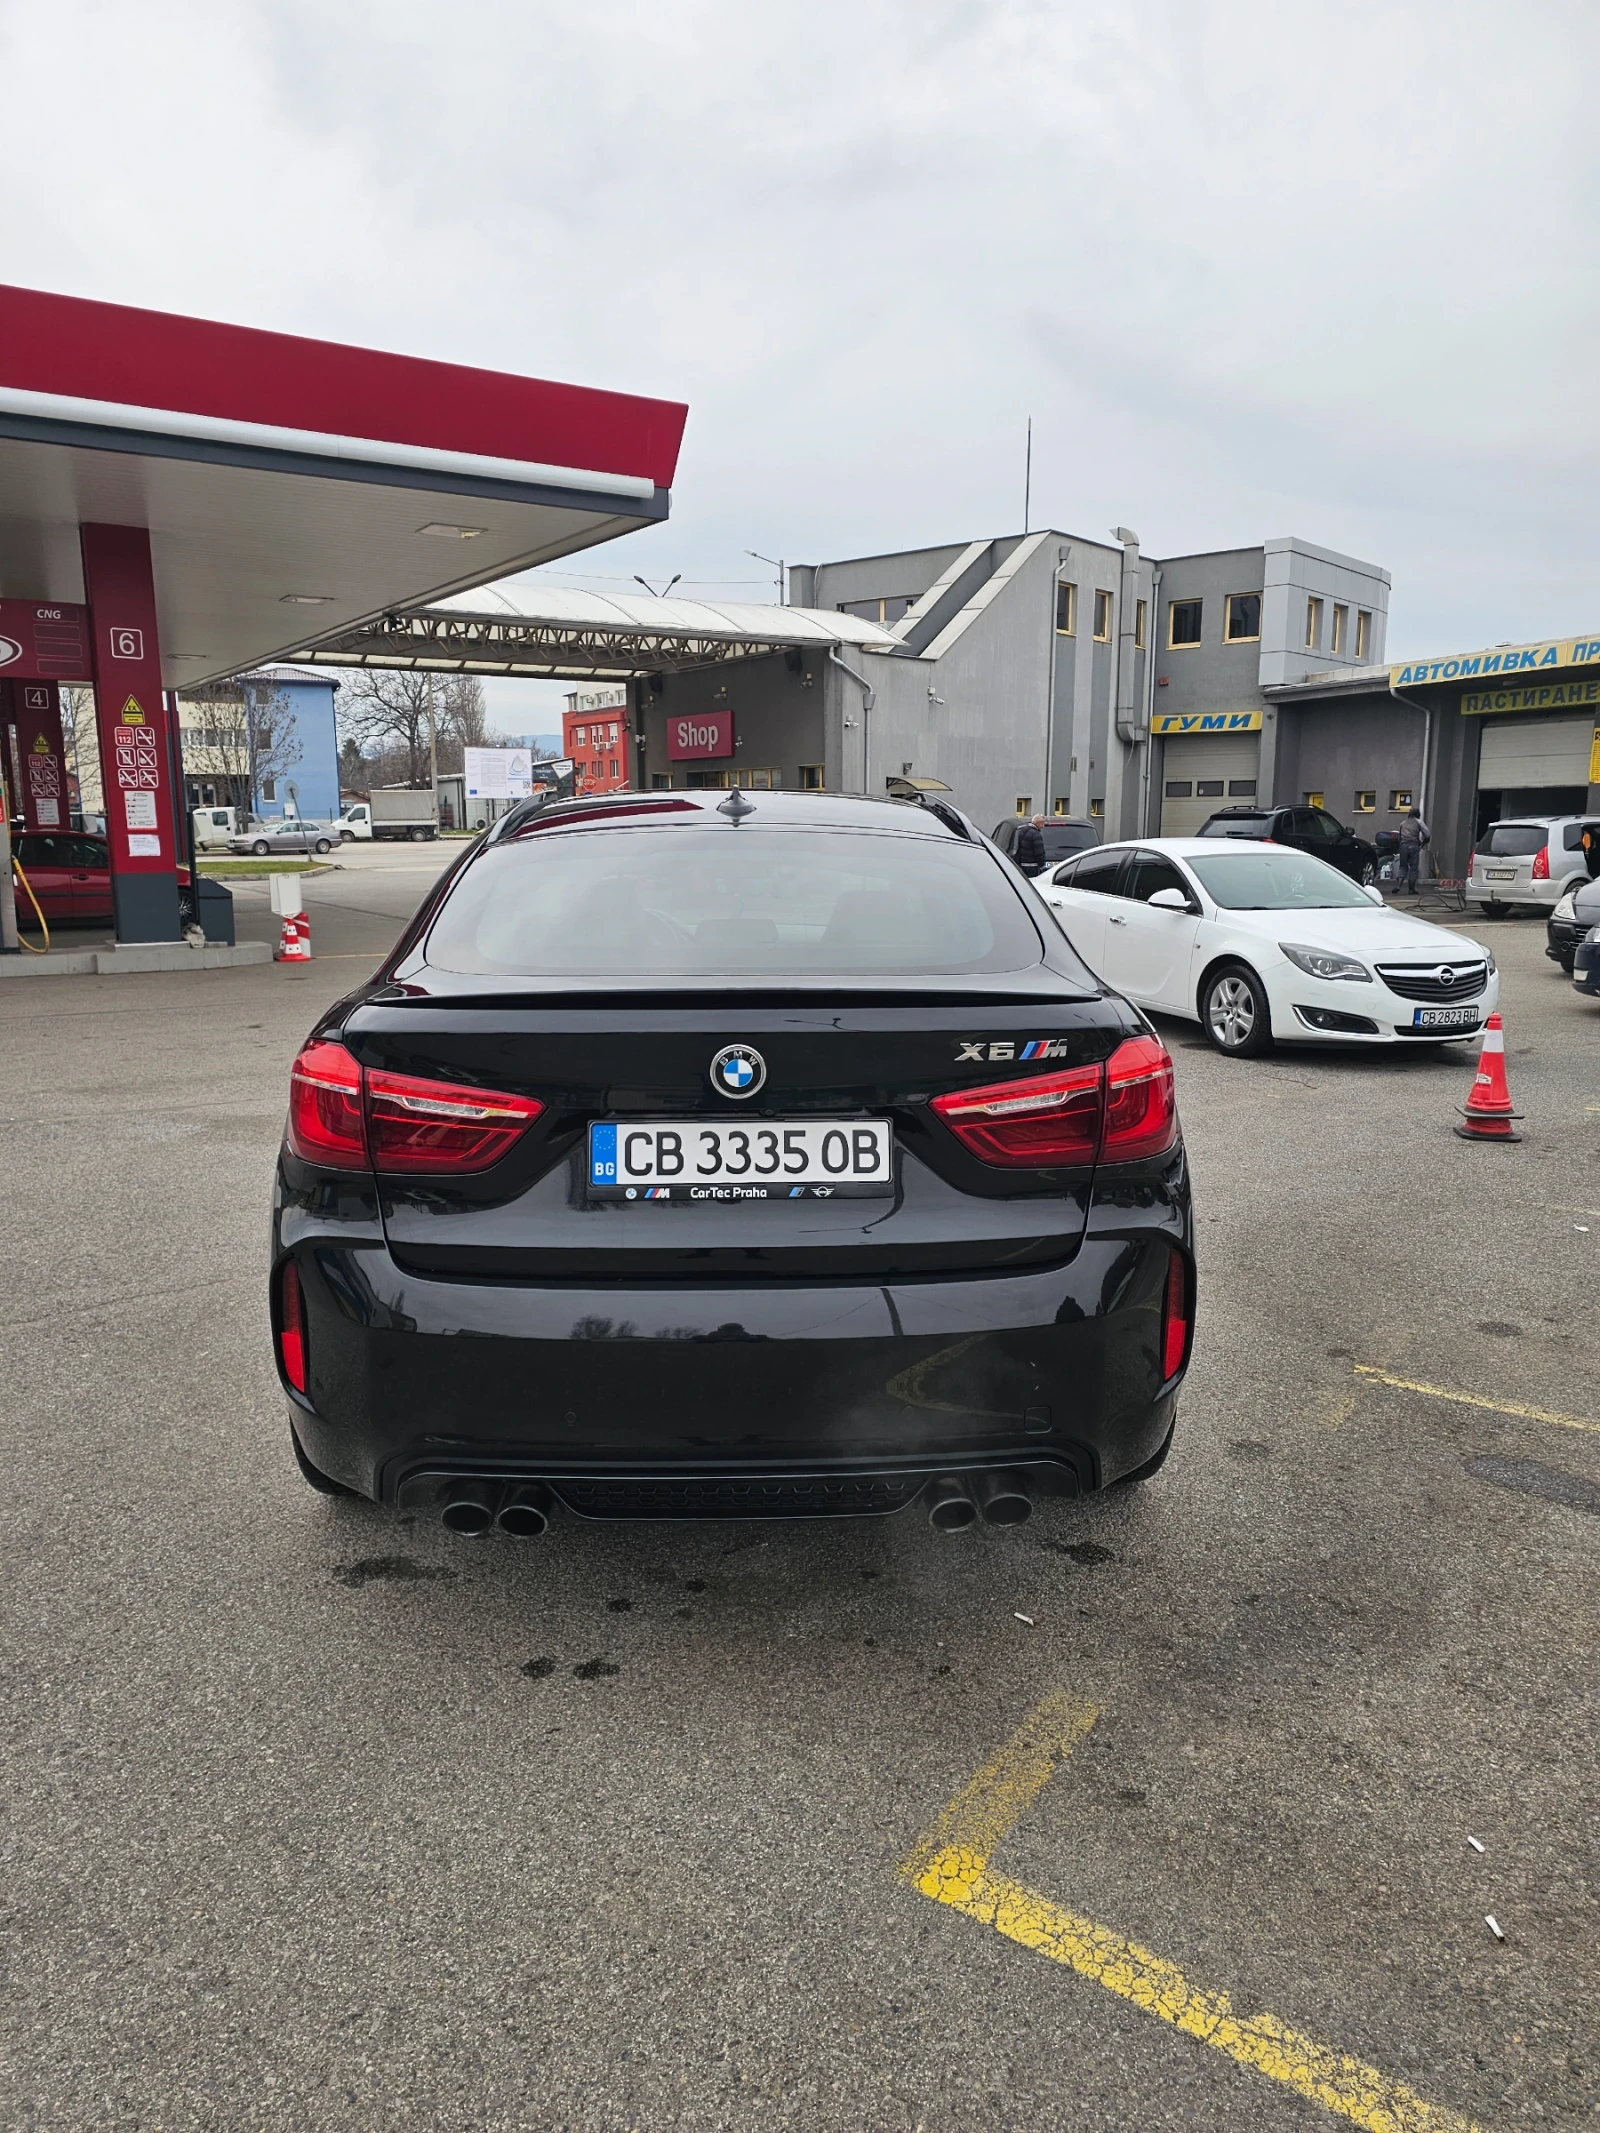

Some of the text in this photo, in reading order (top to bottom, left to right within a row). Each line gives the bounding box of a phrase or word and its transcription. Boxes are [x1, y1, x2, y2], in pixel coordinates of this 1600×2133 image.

[36, 608, 62, 619] CNG
[118, 632, 135, 655] 6
[1397, 642, 1600, 684] АВТОМИВКА ПР
[31, 690, 43, 706] 4
[1466, 683, 1598, 712] ПАСТИРАНЕ
[1161, 713, 1253, 731] ГУМИ
[118, 735, 132, 744] 112
[677, 721, 719, 752] Shop
[1421, 1012, 1436, 1024] CB
[1437, 1011, 1462, 1024] 2823
[954, 1042, 1015, 1061] X6
[625, 1131, 685, 1177] CB
[696, 1130, 810, 1175] 3335
[594, 1162, 615, 1176] BG
[690, 1187, 730, 1199] CarTec
[732, 1187, 768, 1198] Praha
